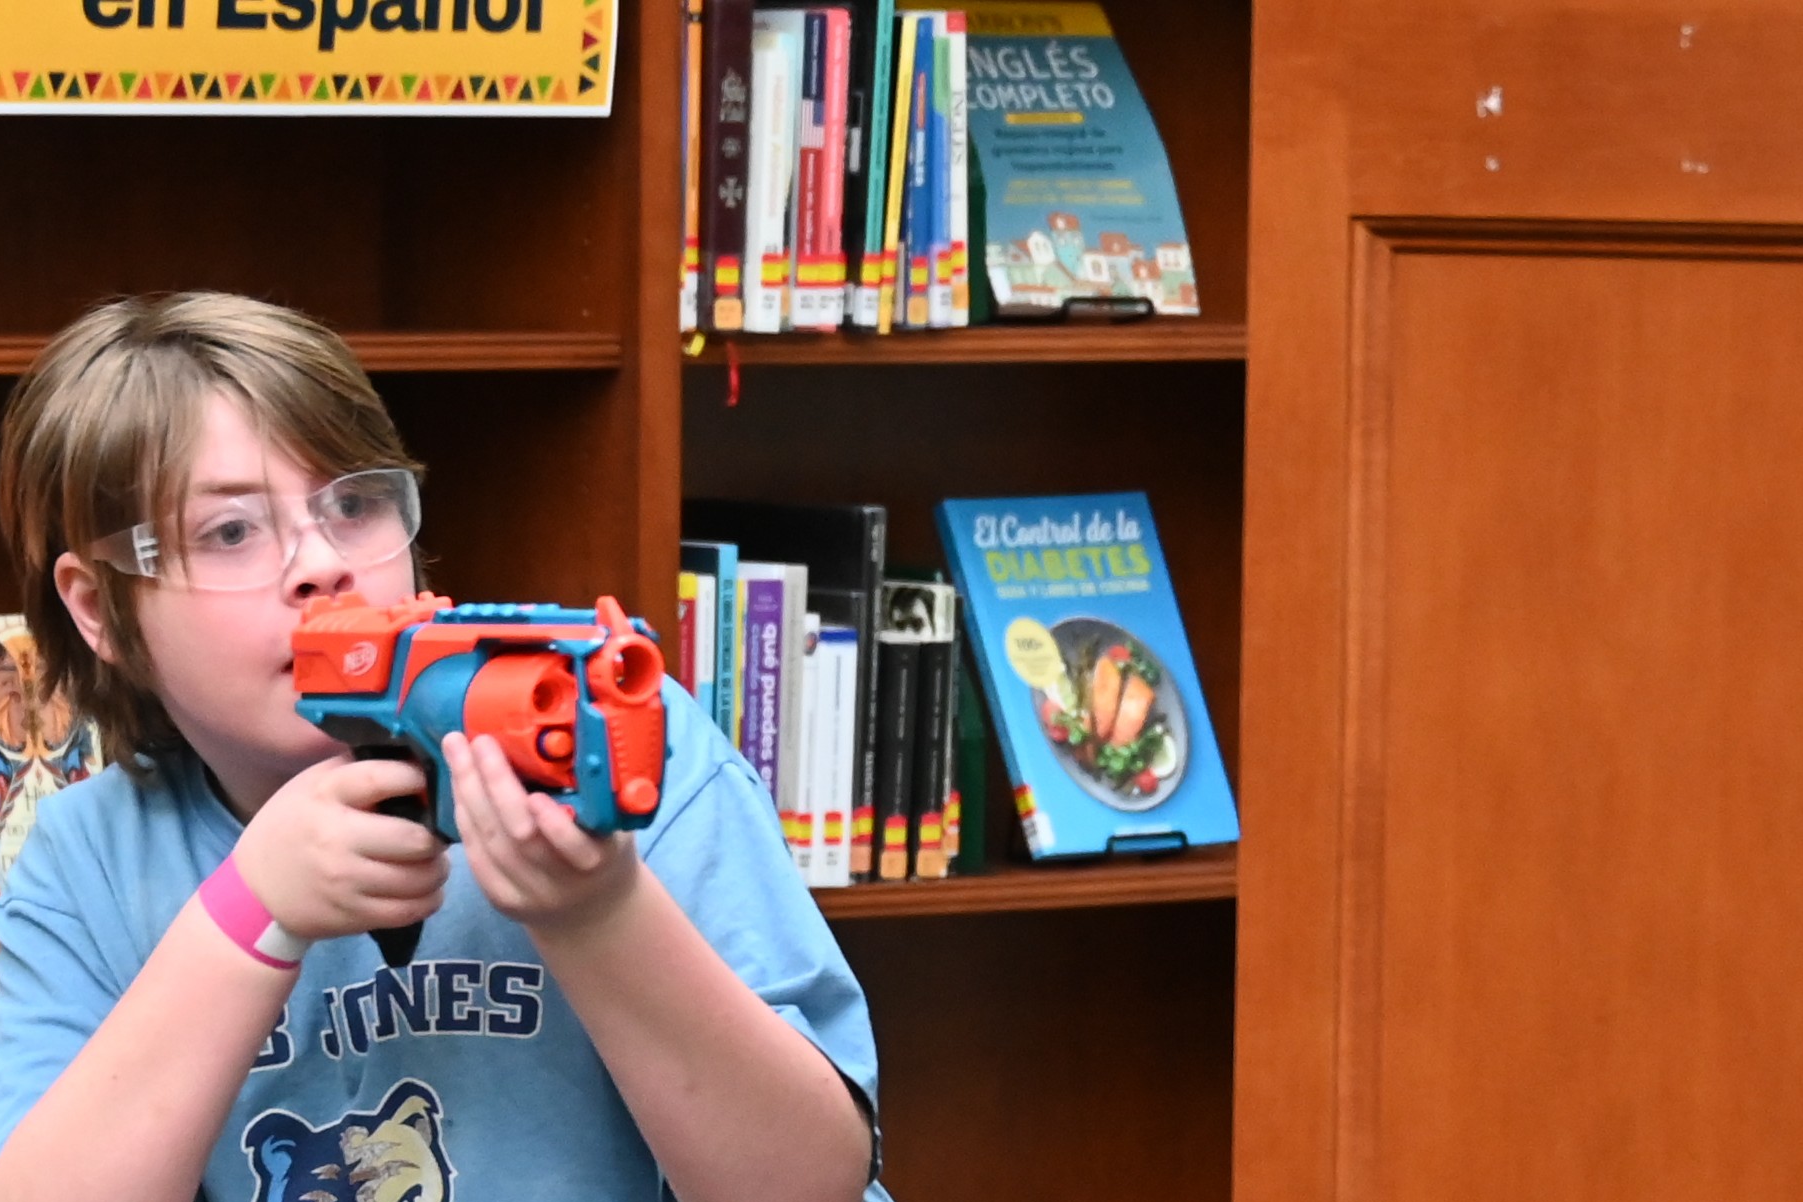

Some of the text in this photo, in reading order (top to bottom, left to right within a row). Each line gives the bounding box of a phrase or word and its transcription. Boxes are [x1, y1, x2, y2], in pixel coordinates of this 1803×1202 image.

[967, 40, 1100, 79] NGLÉS
[974, 509, 1141, 548] El Control de la
[986, 544, 1151, 583] DIABETES
[761, 622, 779, 670] qué
[761, 674, 777, 761] puedes
